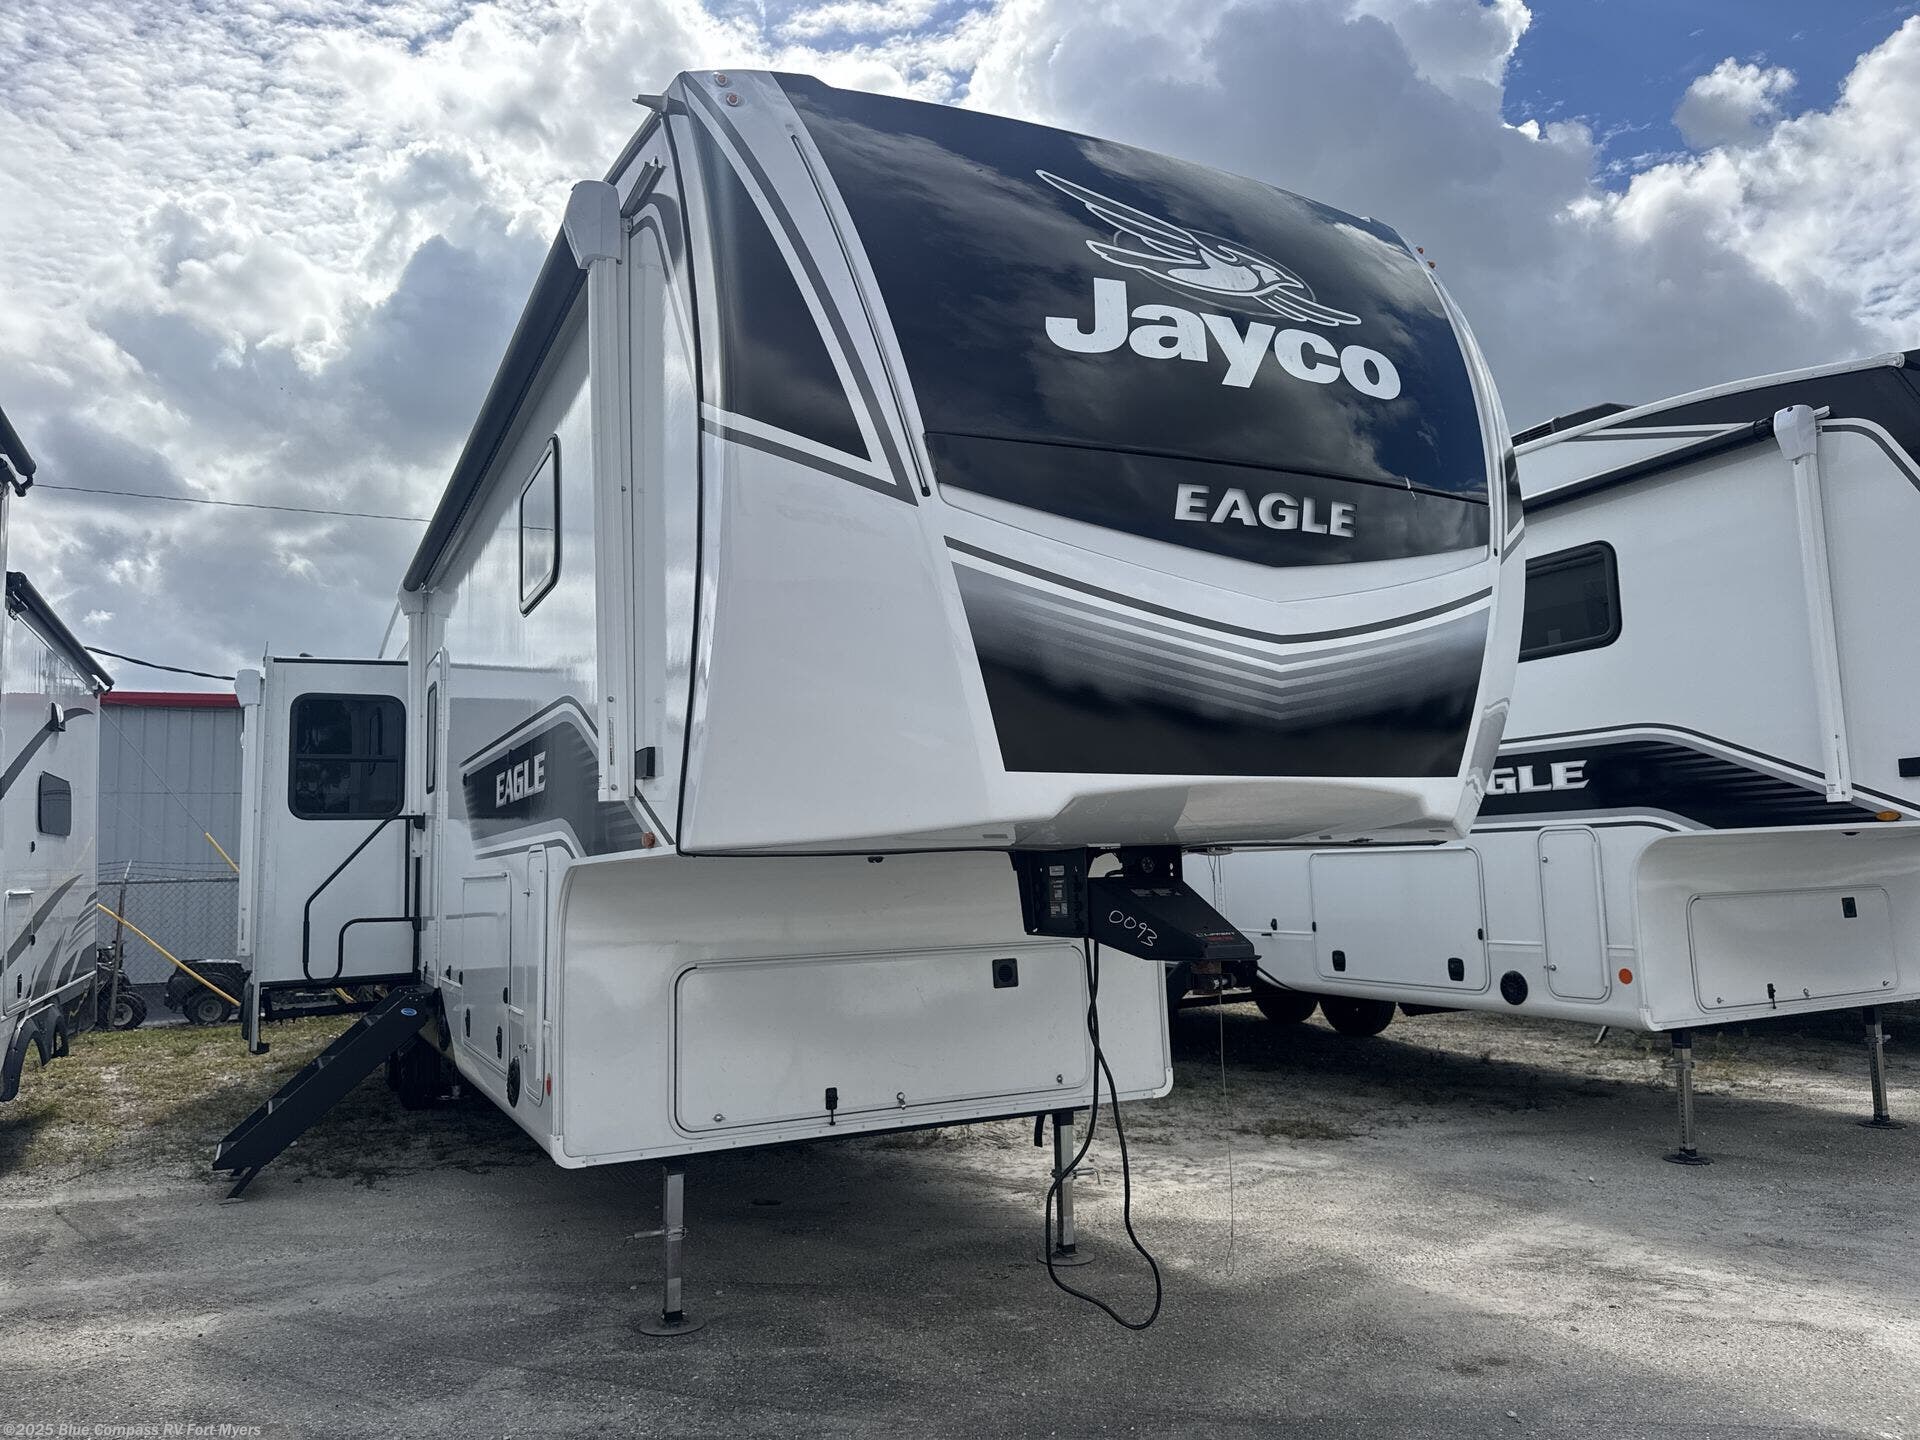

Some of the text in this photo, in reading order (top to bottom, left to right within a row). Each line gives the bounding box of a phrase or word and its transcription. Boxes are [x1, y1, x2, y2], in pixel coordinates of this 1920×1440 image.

[1045, 277, 1401, 400] Jayco
[1174, 483, 1358, 538] EAGLE
[495, 751, 547, 809] EAGLE
[1485, 759, 1590, 796] GLE
[1108, 910, 1158, 946] 0093
